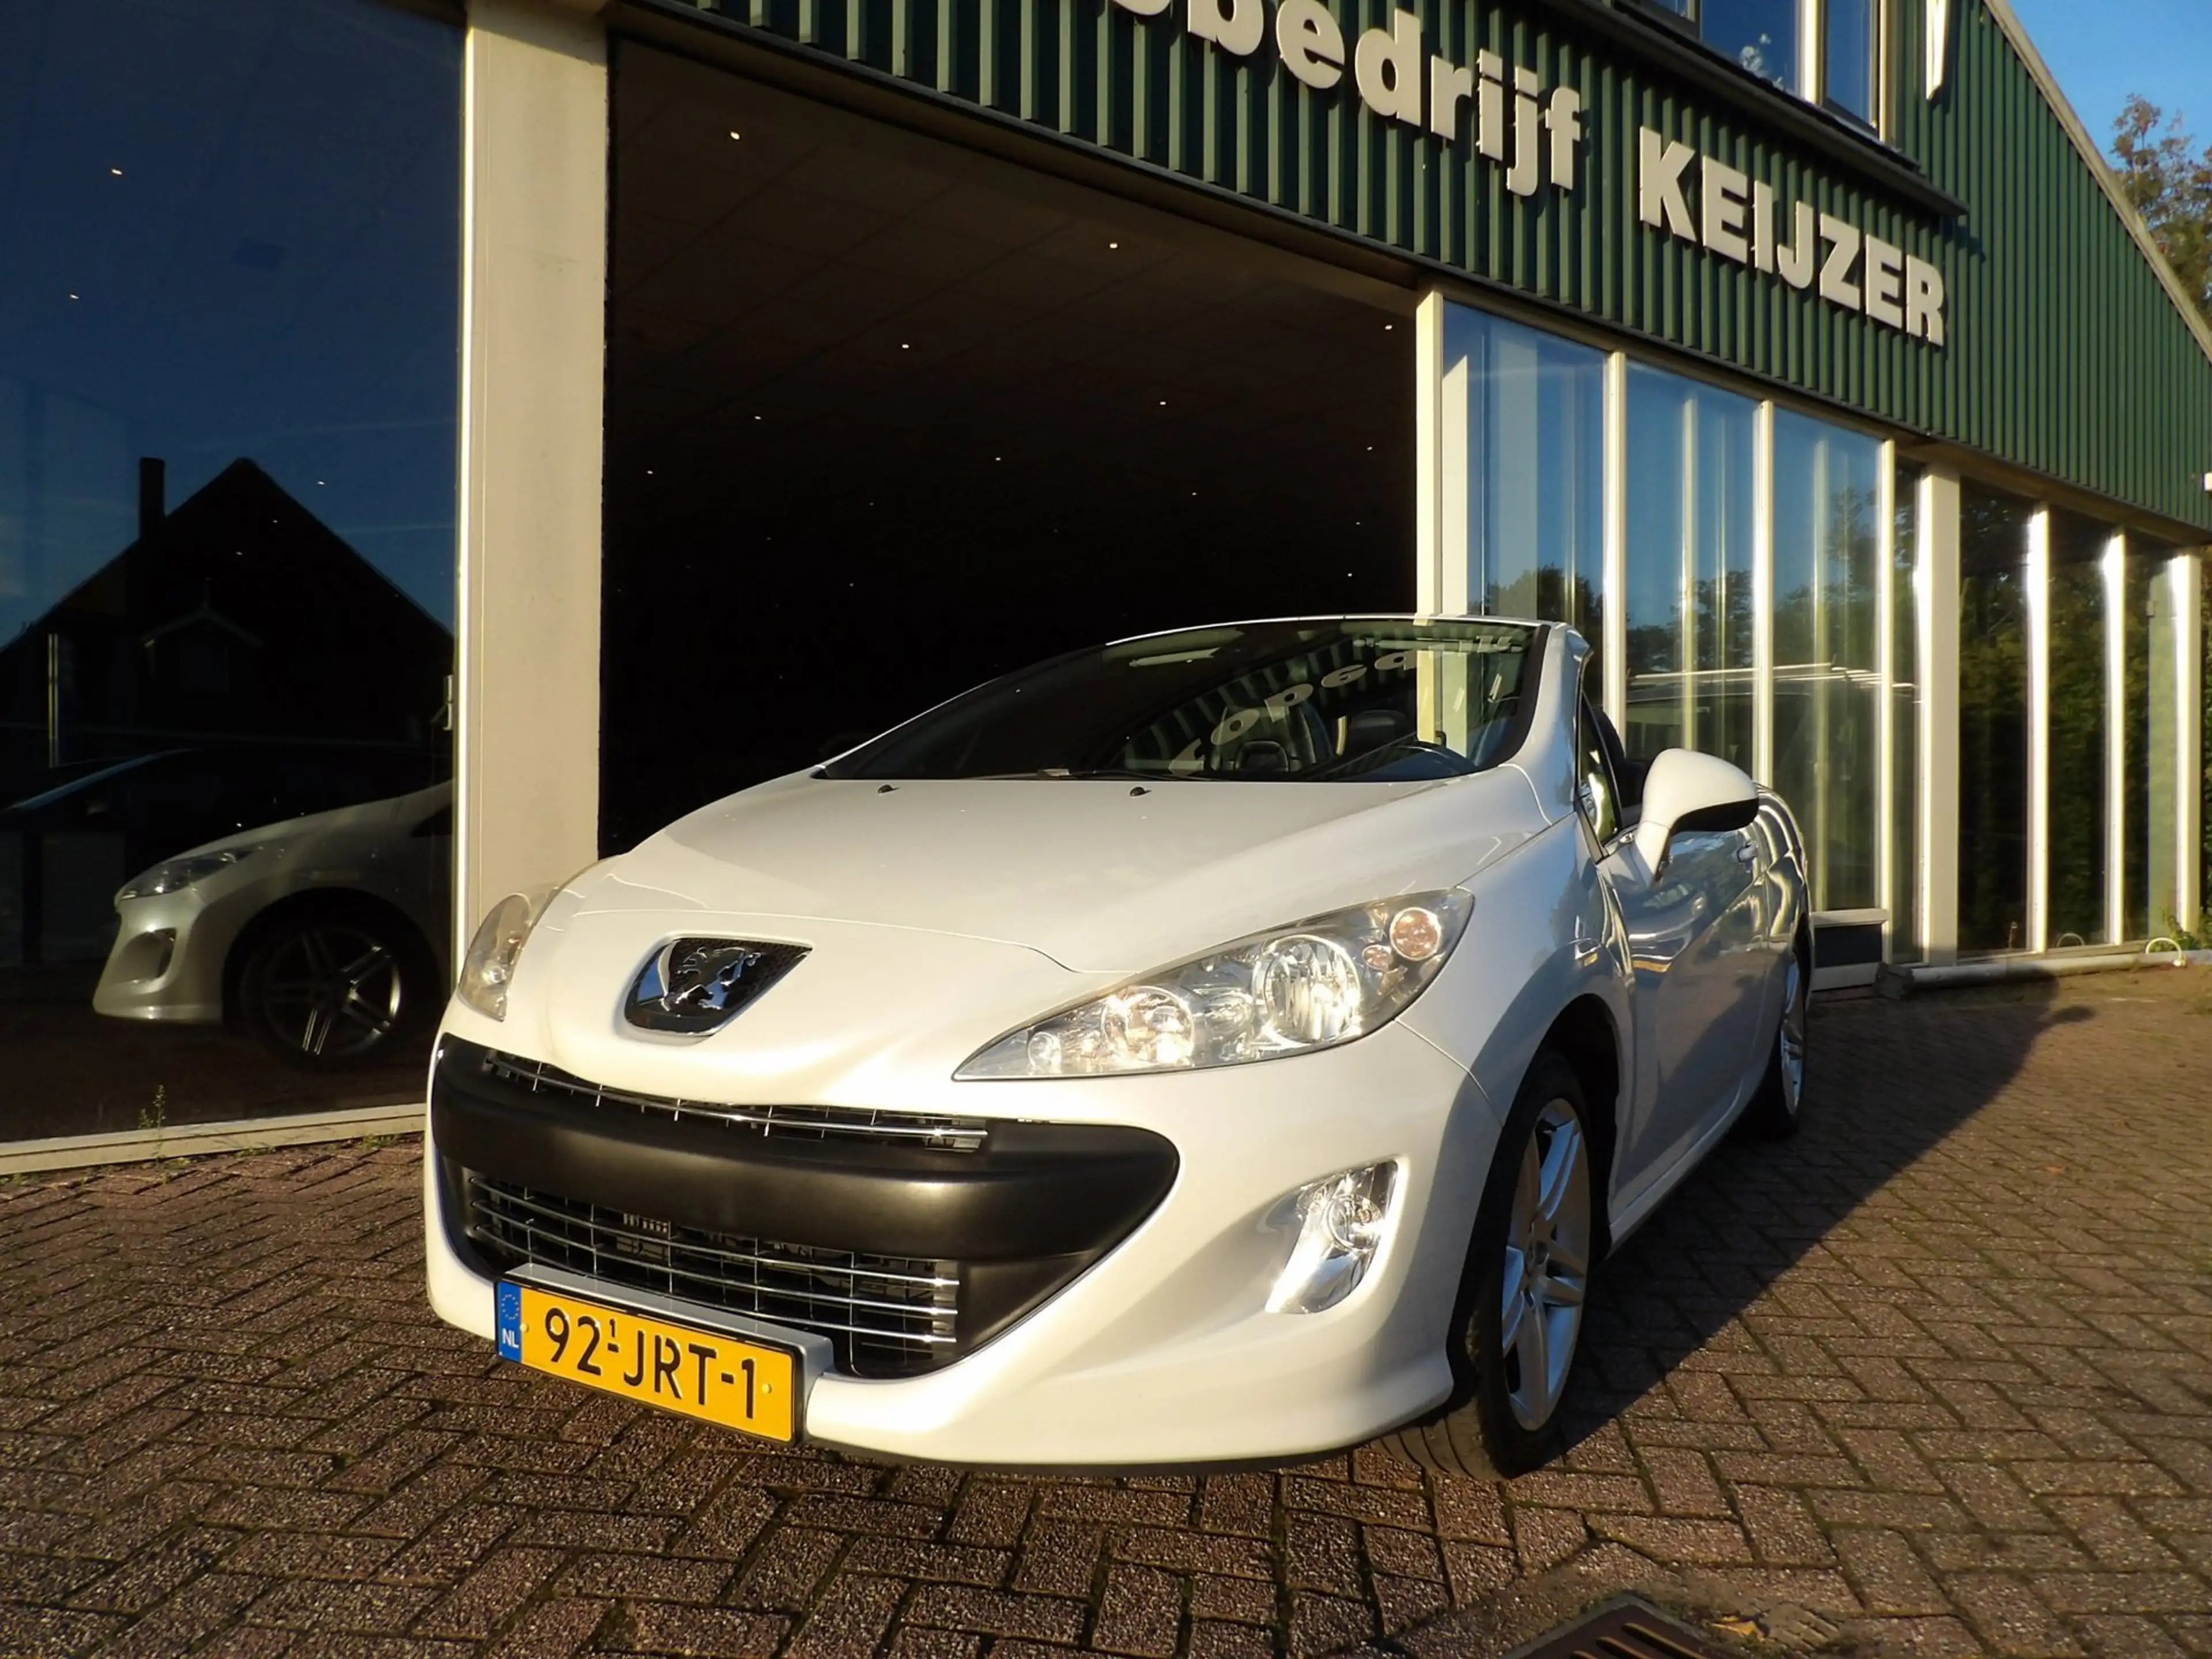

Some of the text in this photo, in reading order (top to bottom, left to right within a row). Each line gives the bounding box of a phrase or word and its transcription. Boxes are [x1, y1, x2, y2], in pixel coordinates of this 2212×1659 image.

[1112, 0, 1944, 347] bedrijf KEIJZER
[502, 1328, 518, 1348] NL
[545, 1307, 755, 1419] 92-JRT-1
